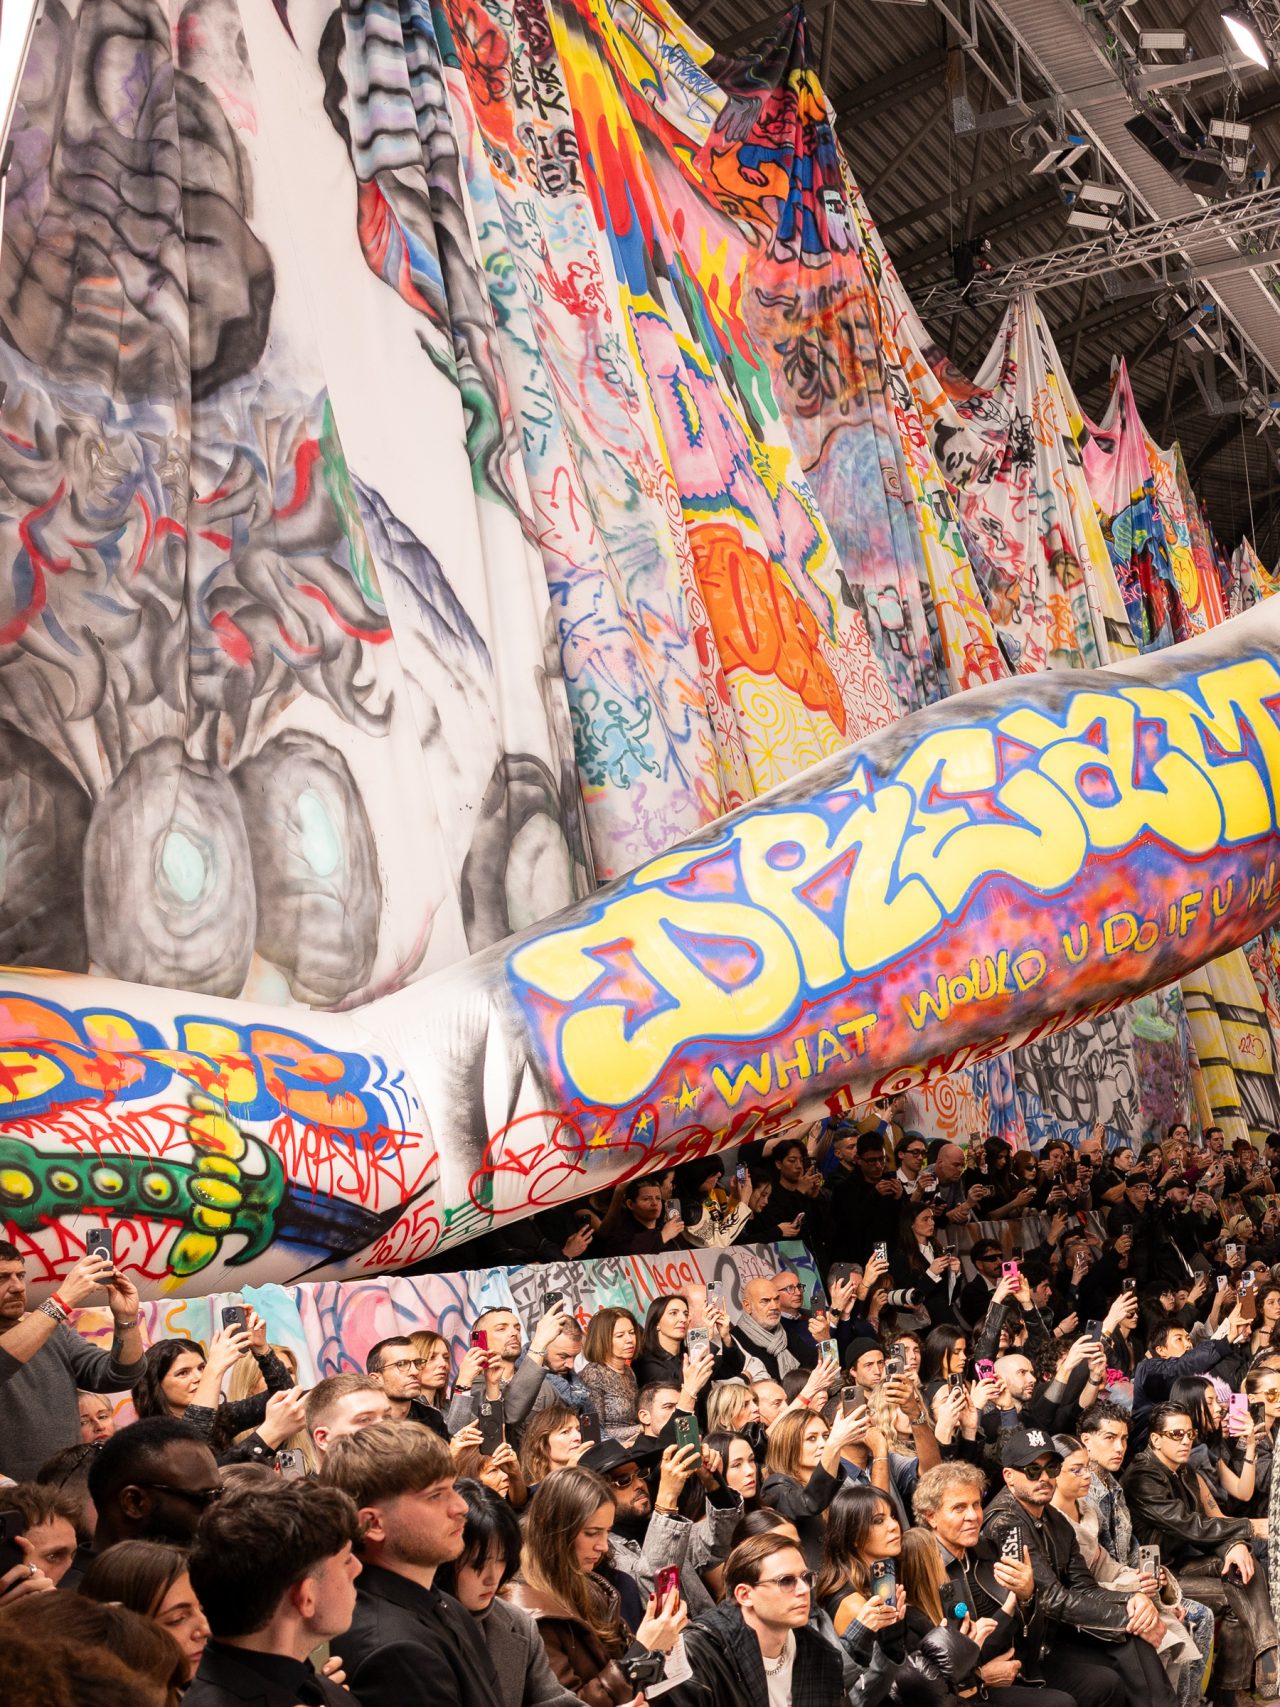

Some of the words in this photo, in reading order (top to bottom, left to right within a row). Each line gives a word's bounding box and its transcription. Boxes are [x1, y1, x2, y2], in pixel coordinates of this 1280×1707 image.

[711, 1012, 878, 1108] WHAT
[901, 948, 1047, 1031] WOULD
[1062, 922, 1090, 965] U
[1168, 888, 1204, 938] IF
[1211, 874, 1234, 918] U
[364, 1199, 441, 1268] 2025
